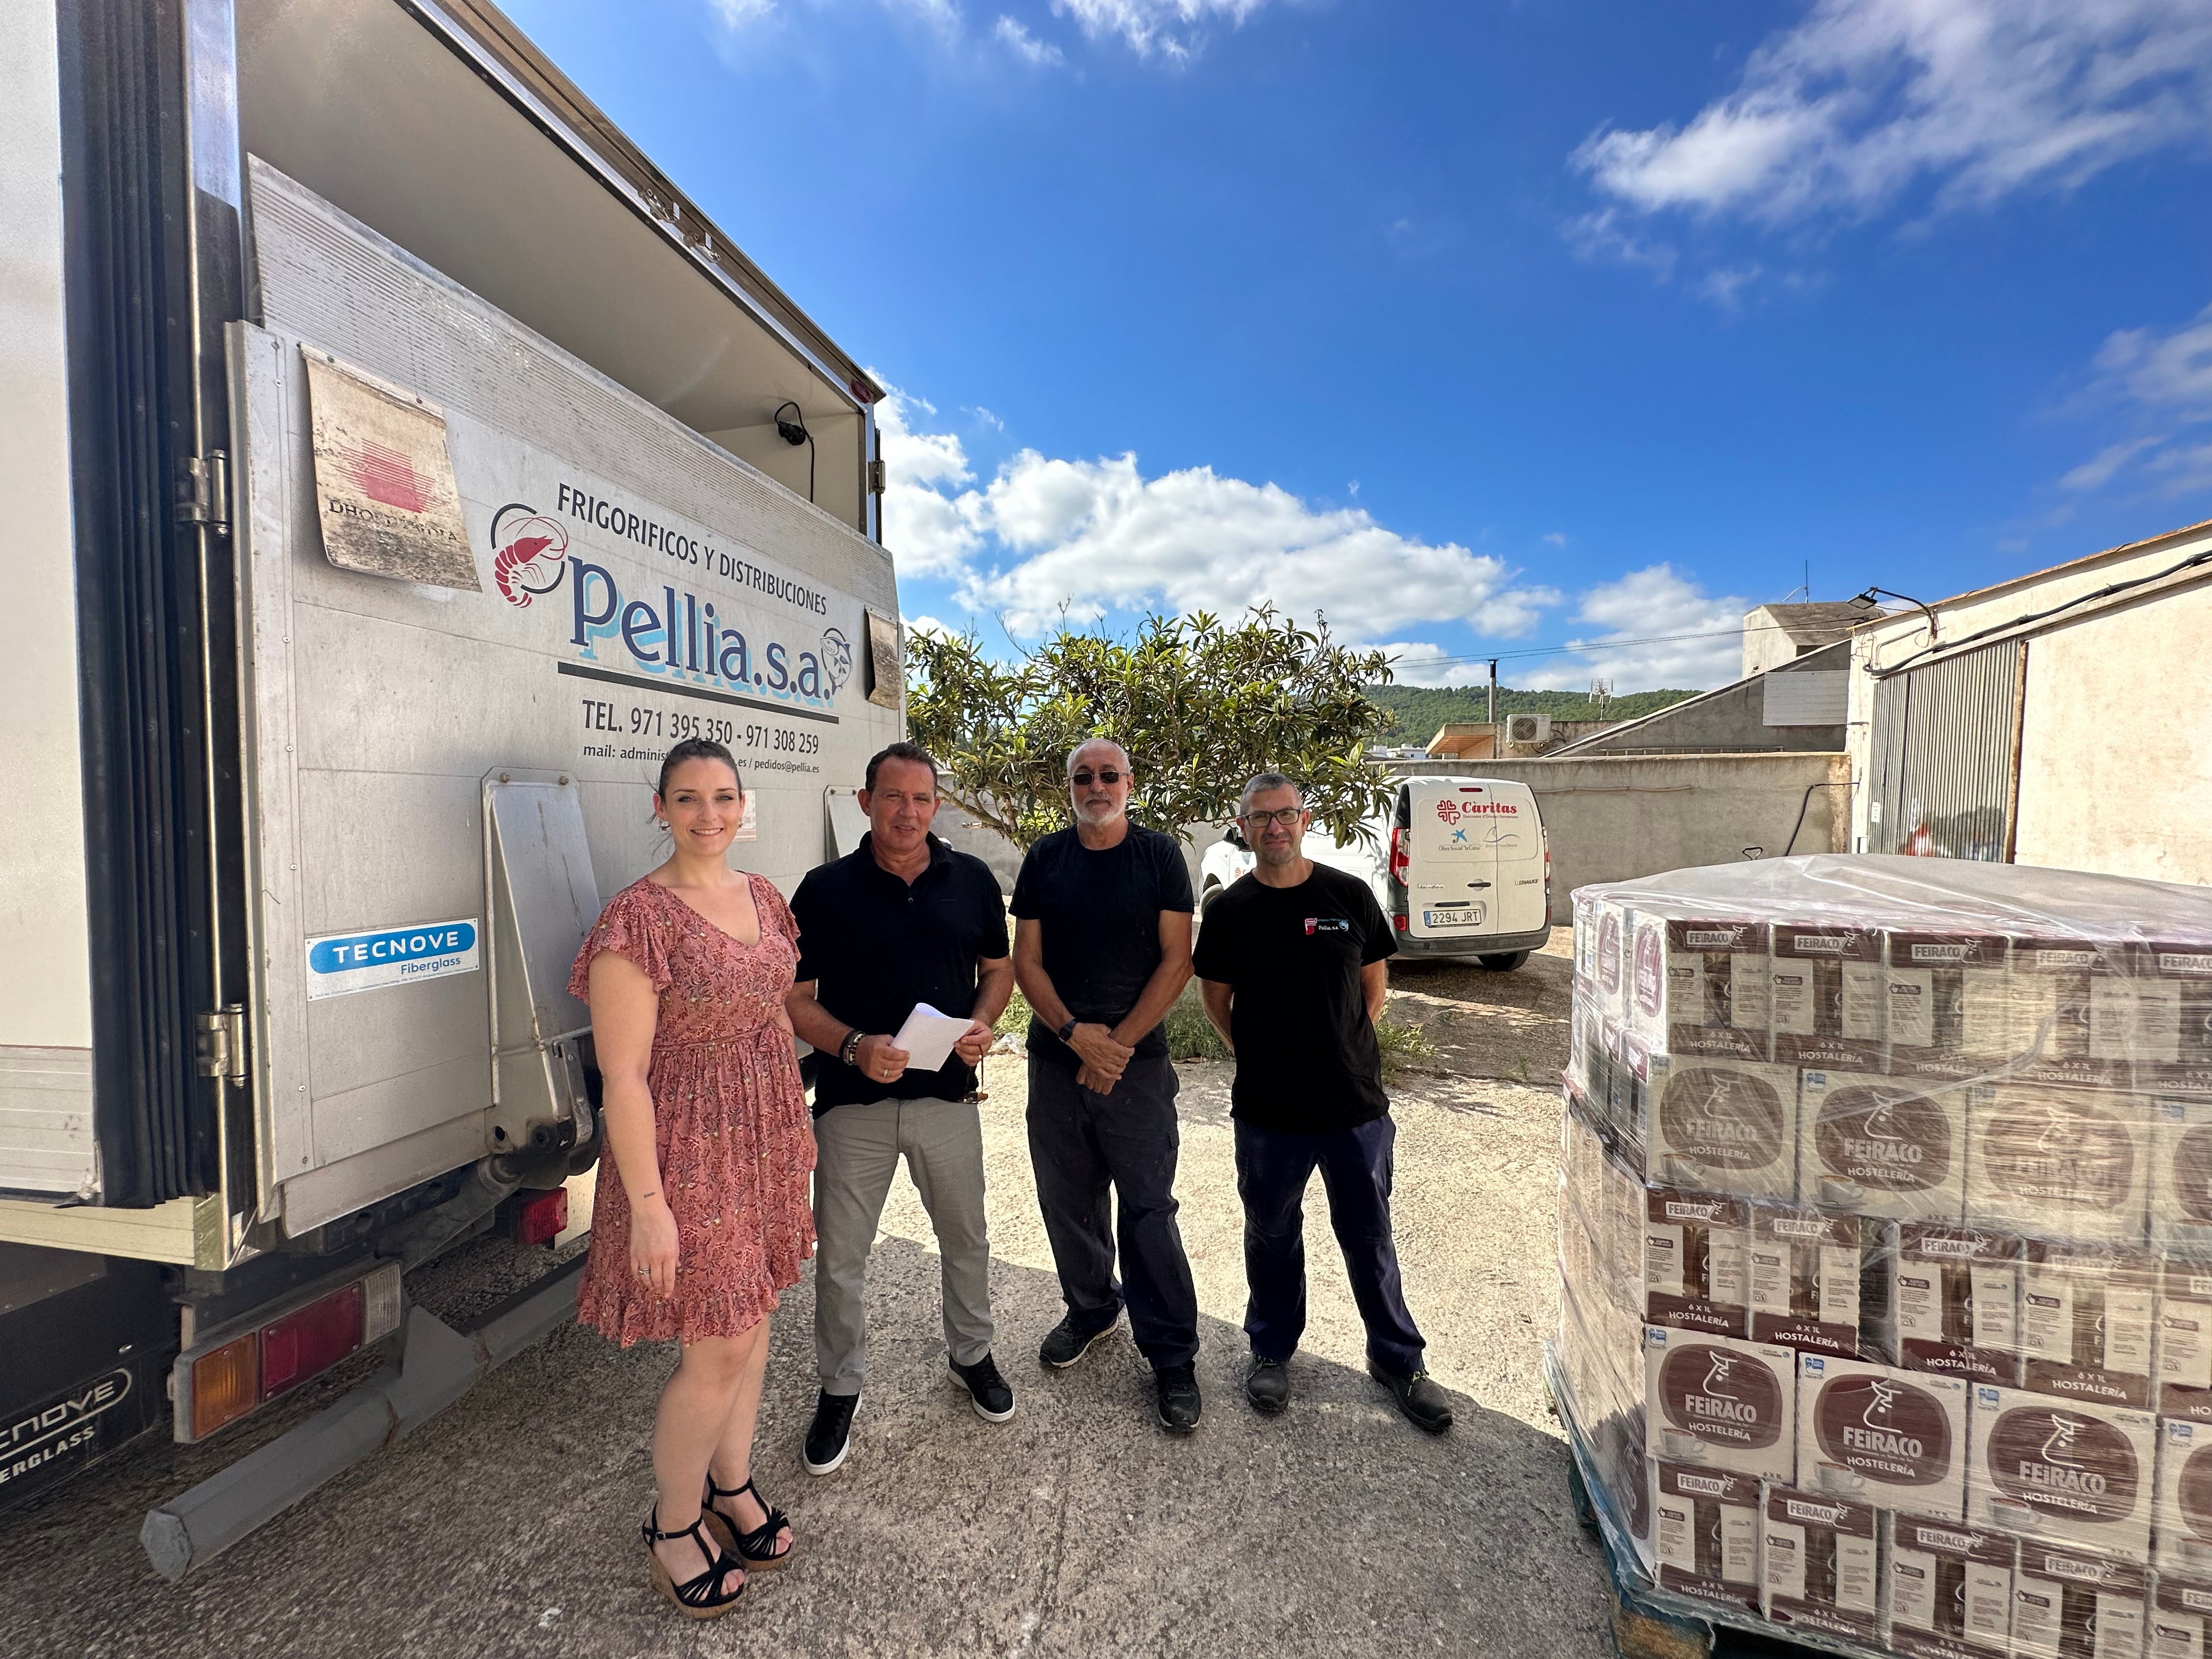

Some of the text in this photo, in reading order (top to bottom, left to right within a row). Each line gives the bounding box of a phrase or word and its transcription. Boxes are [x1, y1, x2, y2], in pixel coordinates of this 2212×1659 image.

[557, 482, 827, 616] FRIGORIFICOS Y DISTRIBUCIONES
[582, 699, 622, 732] TEL.
[631, 707, 662, 736] 971
[670, 713, 700, 740] 395
[706, 718, 732, 744] 350
[747, 725, 769, 749] 971
[774, 729, 795, 752] 308
[799, 732, 819, 754] 259
[583, 744, 616, 758] mail:
[754, 759, 820, 773] pedidos@pellia.es
[1462, 801, 1517, 814] Càritas
[1432, 911, 1477, 923] 2294 JRT
[332, 931, 459, 963] TECNOVE
[400, 957, 460, 975] Fiberglass
[1669, 1311, 1729, 1328] HOSTALERÍA
[1775, 1332, 1839, 1350] HOSTALERÍA
[2052, 1380, 2128, 1400] HOSTALERÍA
[1689, 1422, 1751, 1441] HOSTELERÍA
[1847, 1457, 1915, 1477] HOSTELERÍA
